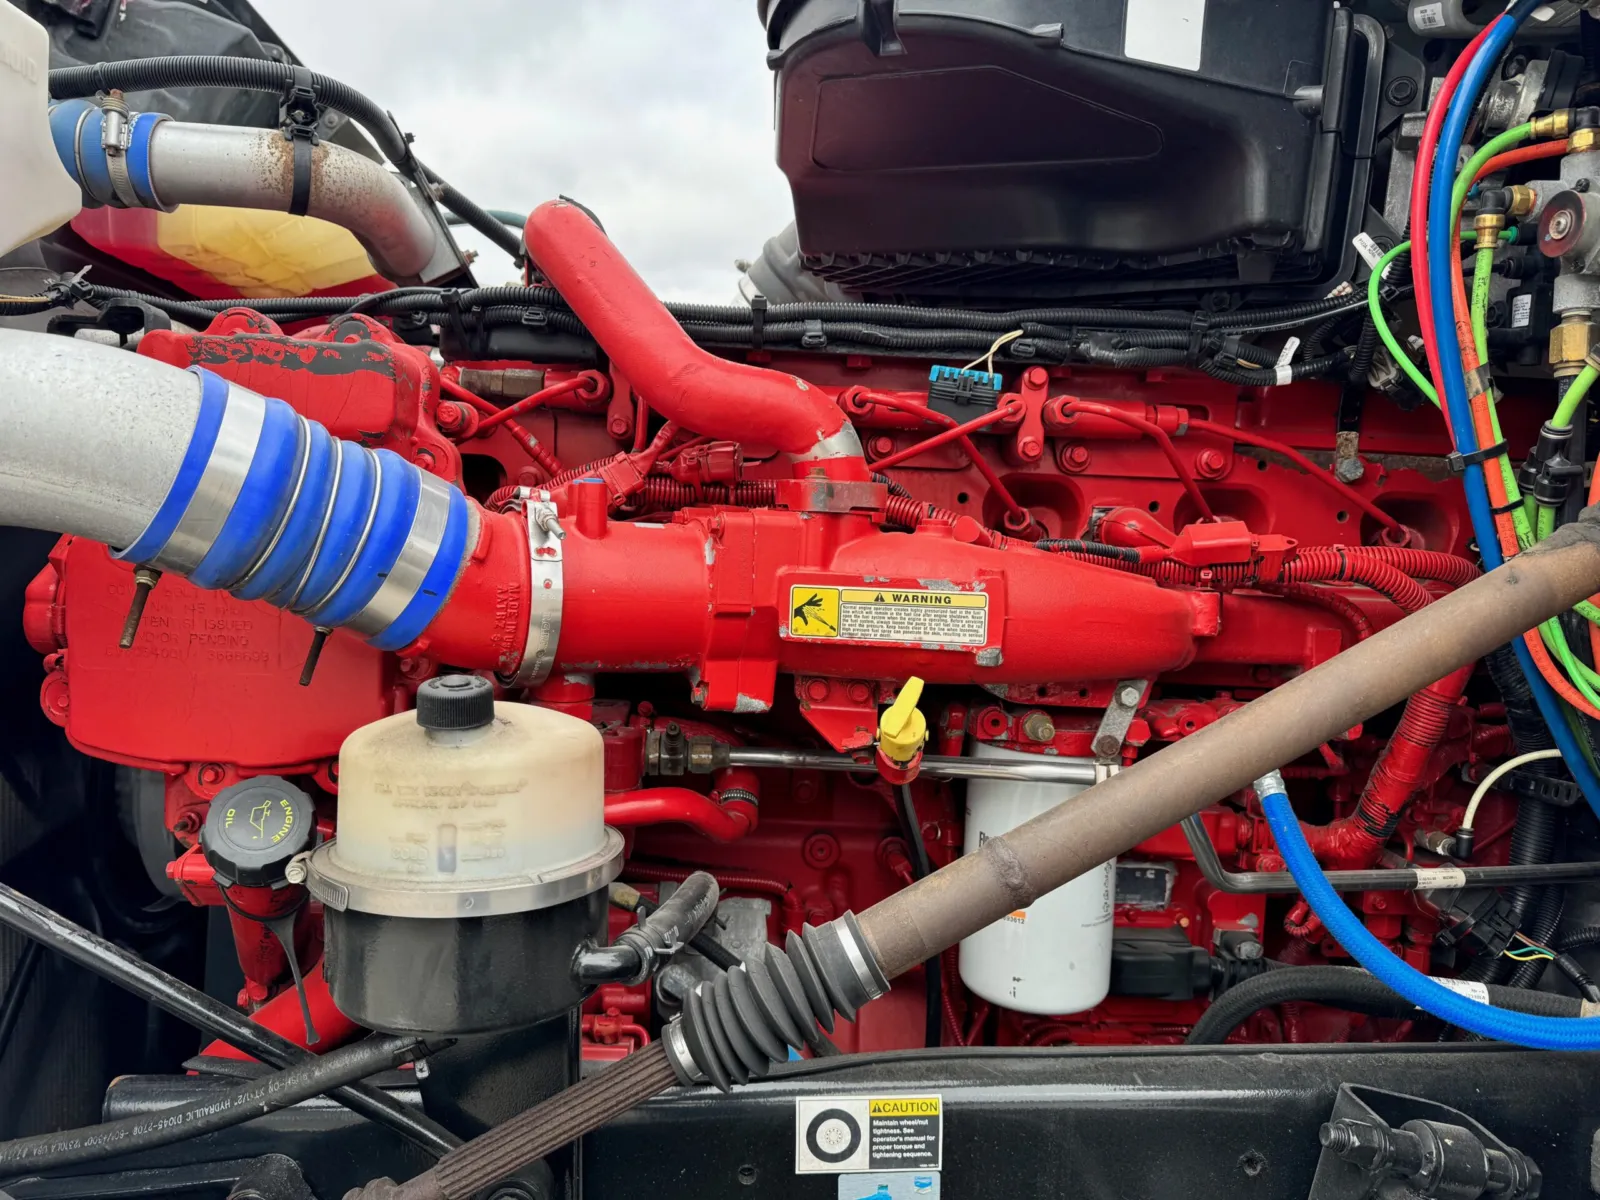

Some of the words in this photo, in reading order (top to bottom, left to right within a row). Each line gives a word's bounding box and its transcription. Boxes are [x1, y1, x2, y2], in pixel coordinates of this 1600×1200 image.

[507, 583, 520, 618] MADE
[892, 594, 952, 604] WARNING
[205, 618, 253, 630] ISSUED
[506, 620, 518, 634] IN
[190, 633, 249, 647] PENDING
[225, 808, 236, 828] OIL
[271, 799, 294, 843] ENGINE
[183, 1102, 231, 1121] HYDRAULIC
[882, 1102, 938, 1112] CAUTION
